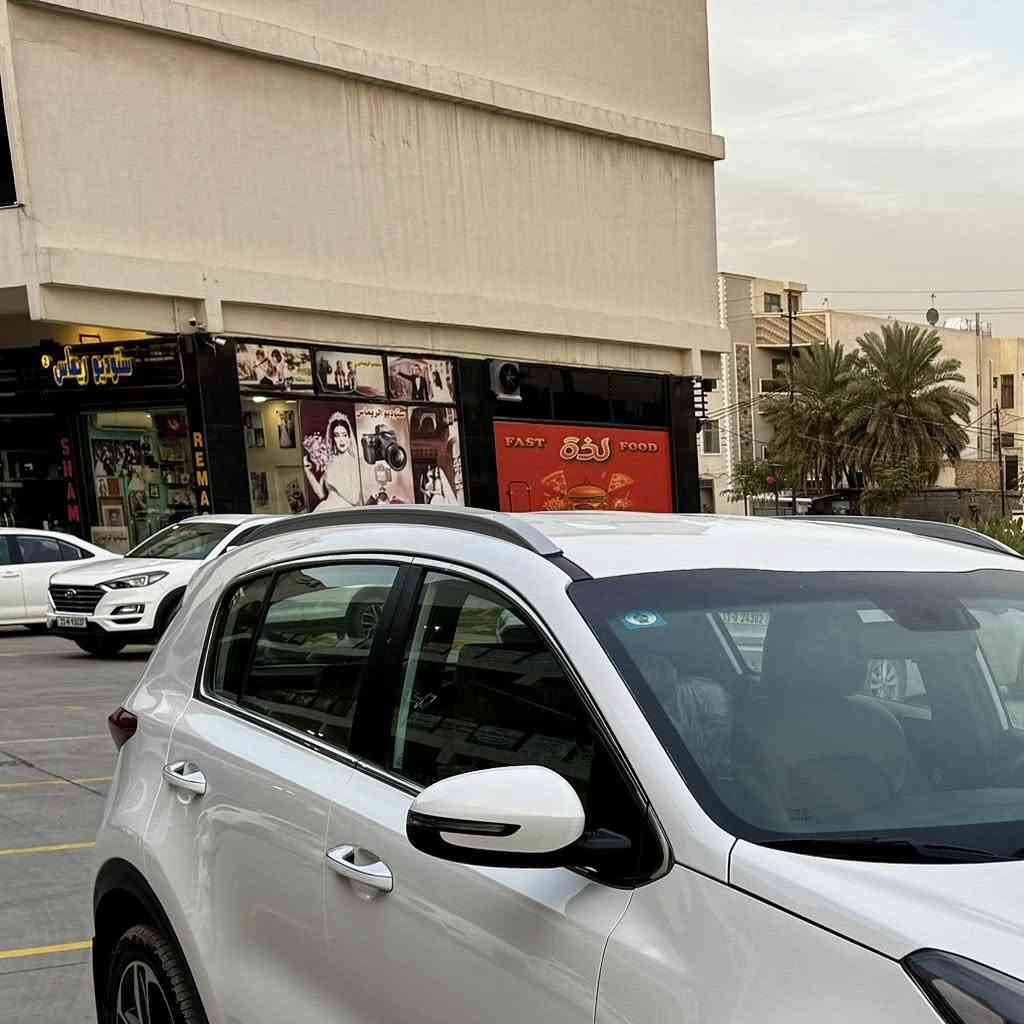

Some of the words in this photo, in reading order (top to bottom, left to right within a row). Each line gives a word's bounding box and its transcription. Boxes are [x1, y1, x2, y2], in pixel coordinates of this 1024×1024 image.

[504, 436, 546, 448] FAST
[619, 441, 658, 452] FOOD
[559, 436, 611, 462] لذة
